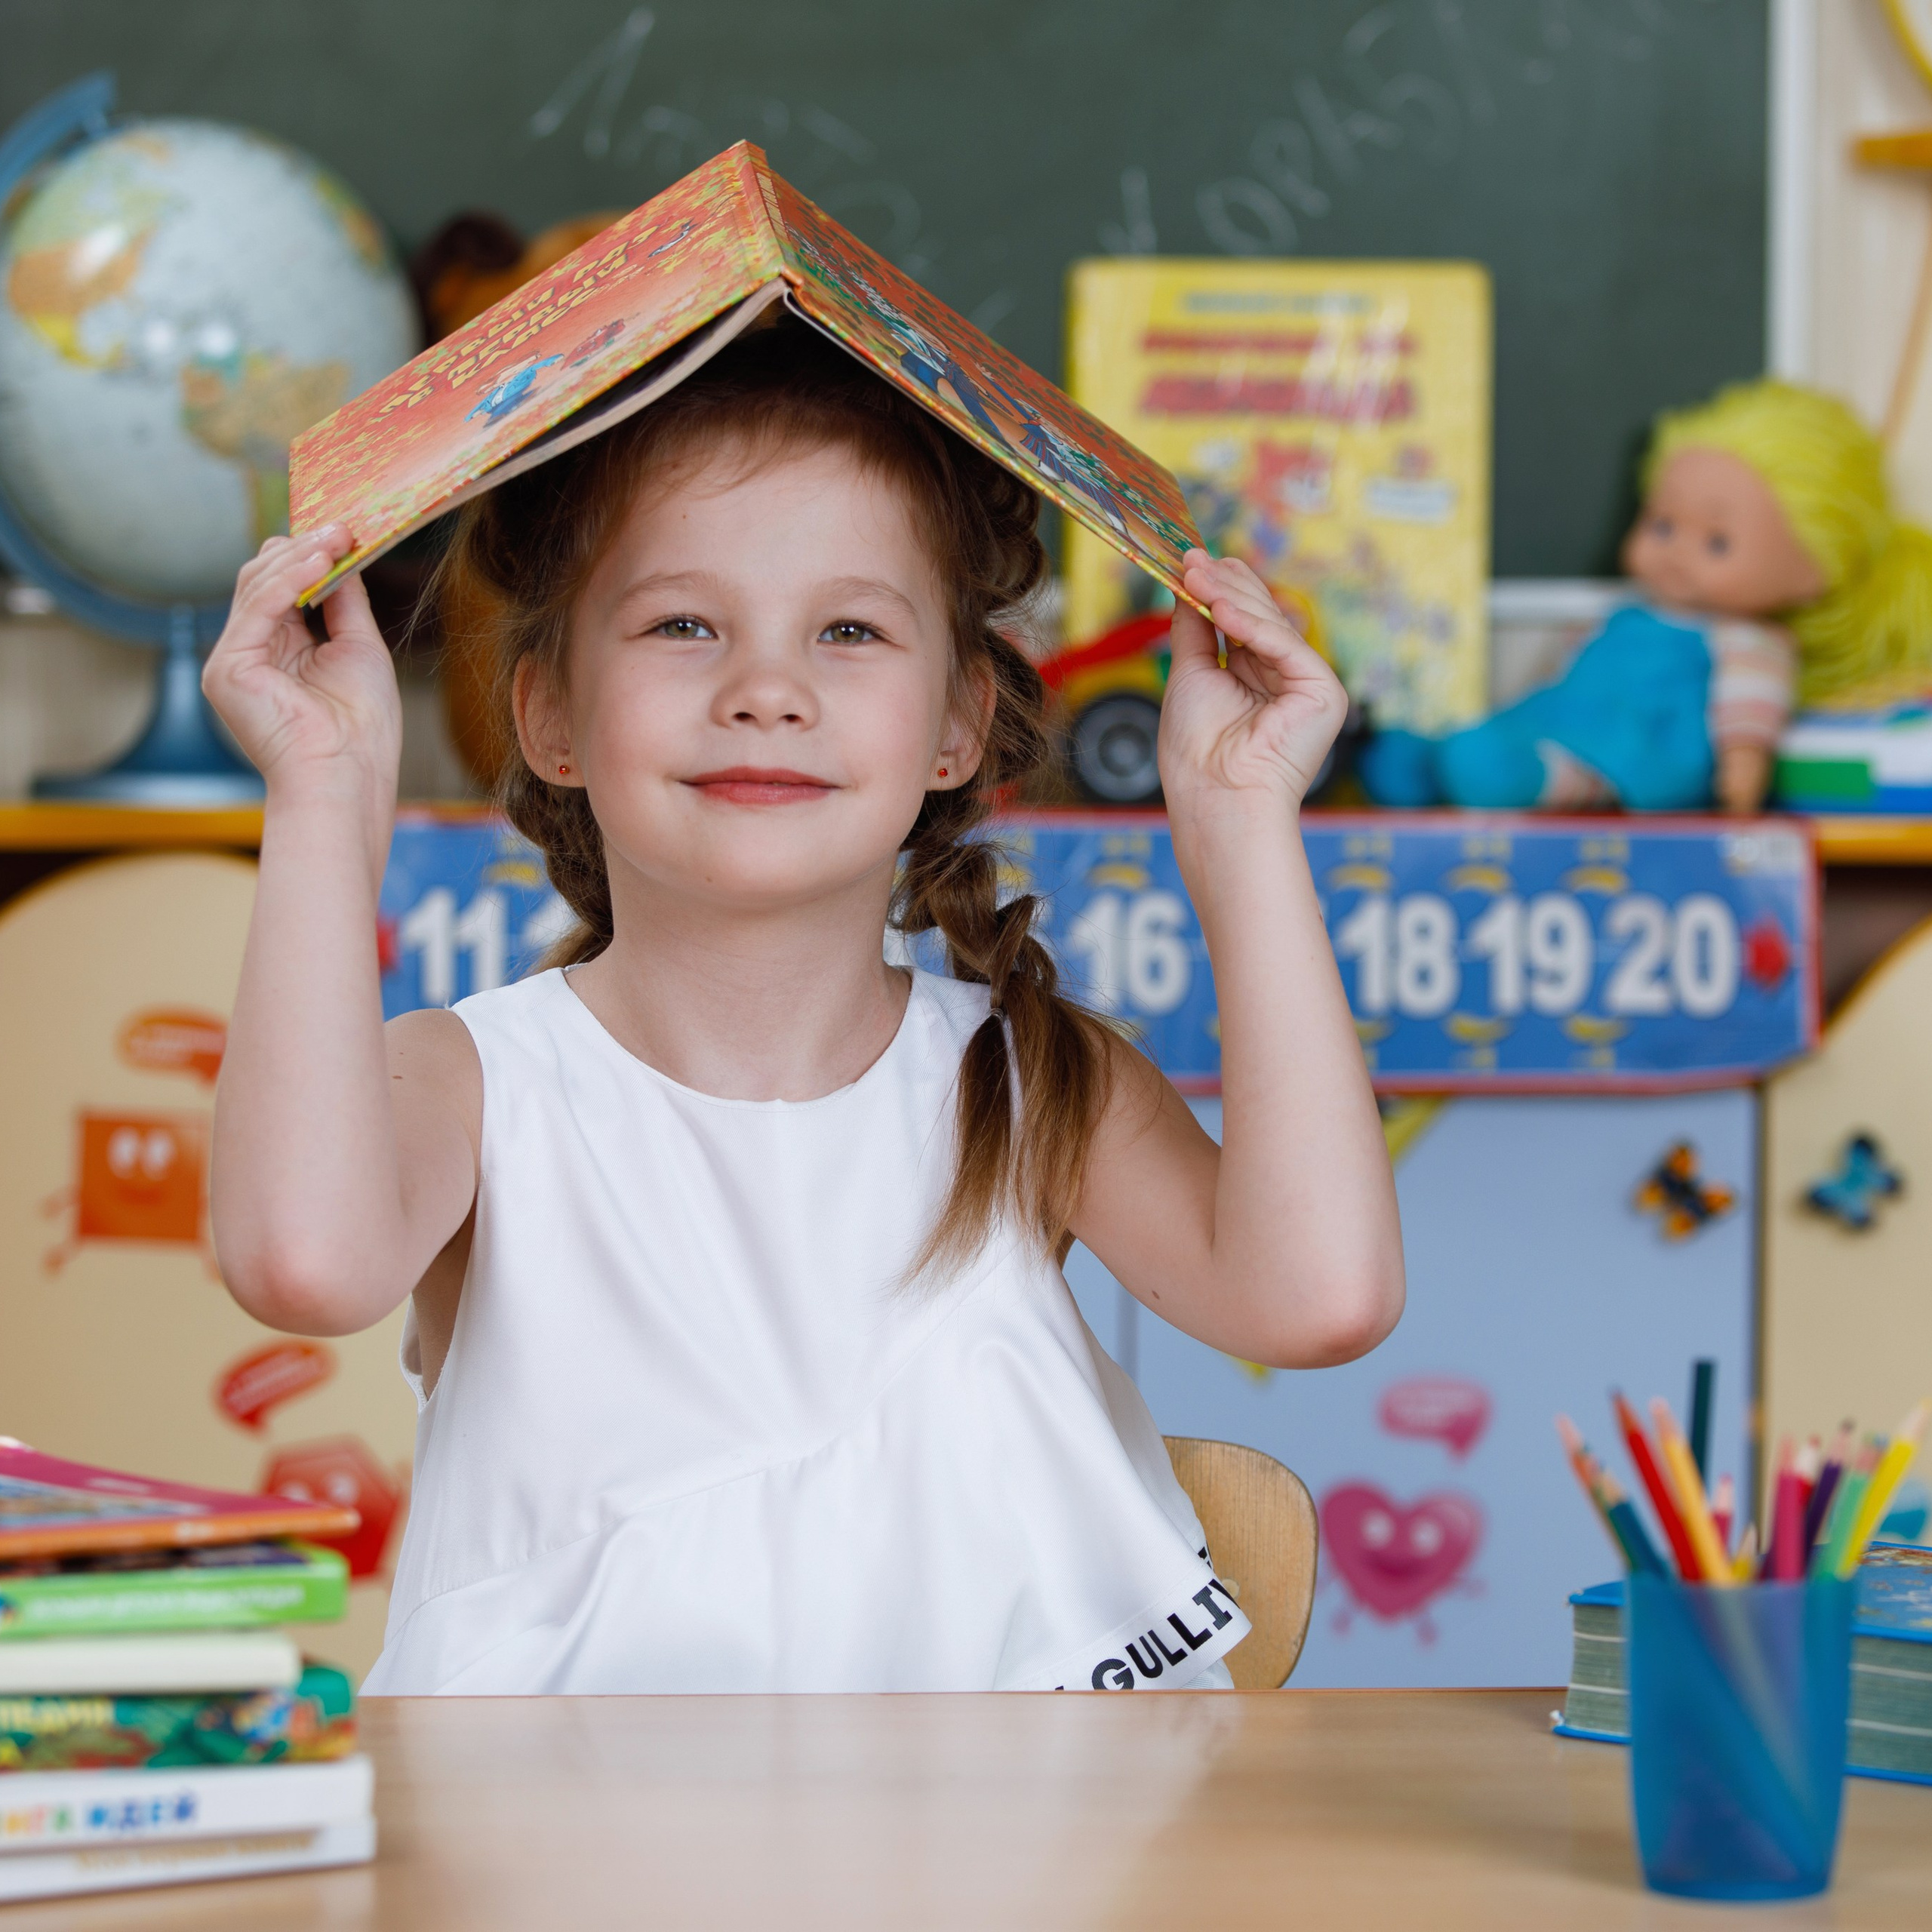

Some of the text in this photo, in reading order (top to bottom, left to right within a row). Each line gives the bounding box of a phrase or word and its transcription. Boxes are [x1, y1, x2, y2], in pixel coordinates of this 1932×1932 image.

[379, 224, 661, 414] ПЕРВЫЙ РАЗ
[408, 253, 628, 408] В ПЕРВЫЙ
[452, 286, 599, 389] КЛАСС
[405, 885, 507, 1004] 11
[1069, 893, 1190, 1015] 16
[1337, 894, 1460, 1017] 18
[1470, 893, 1592, 1014] 19
[1607, 894, 1740, 1017] 20
